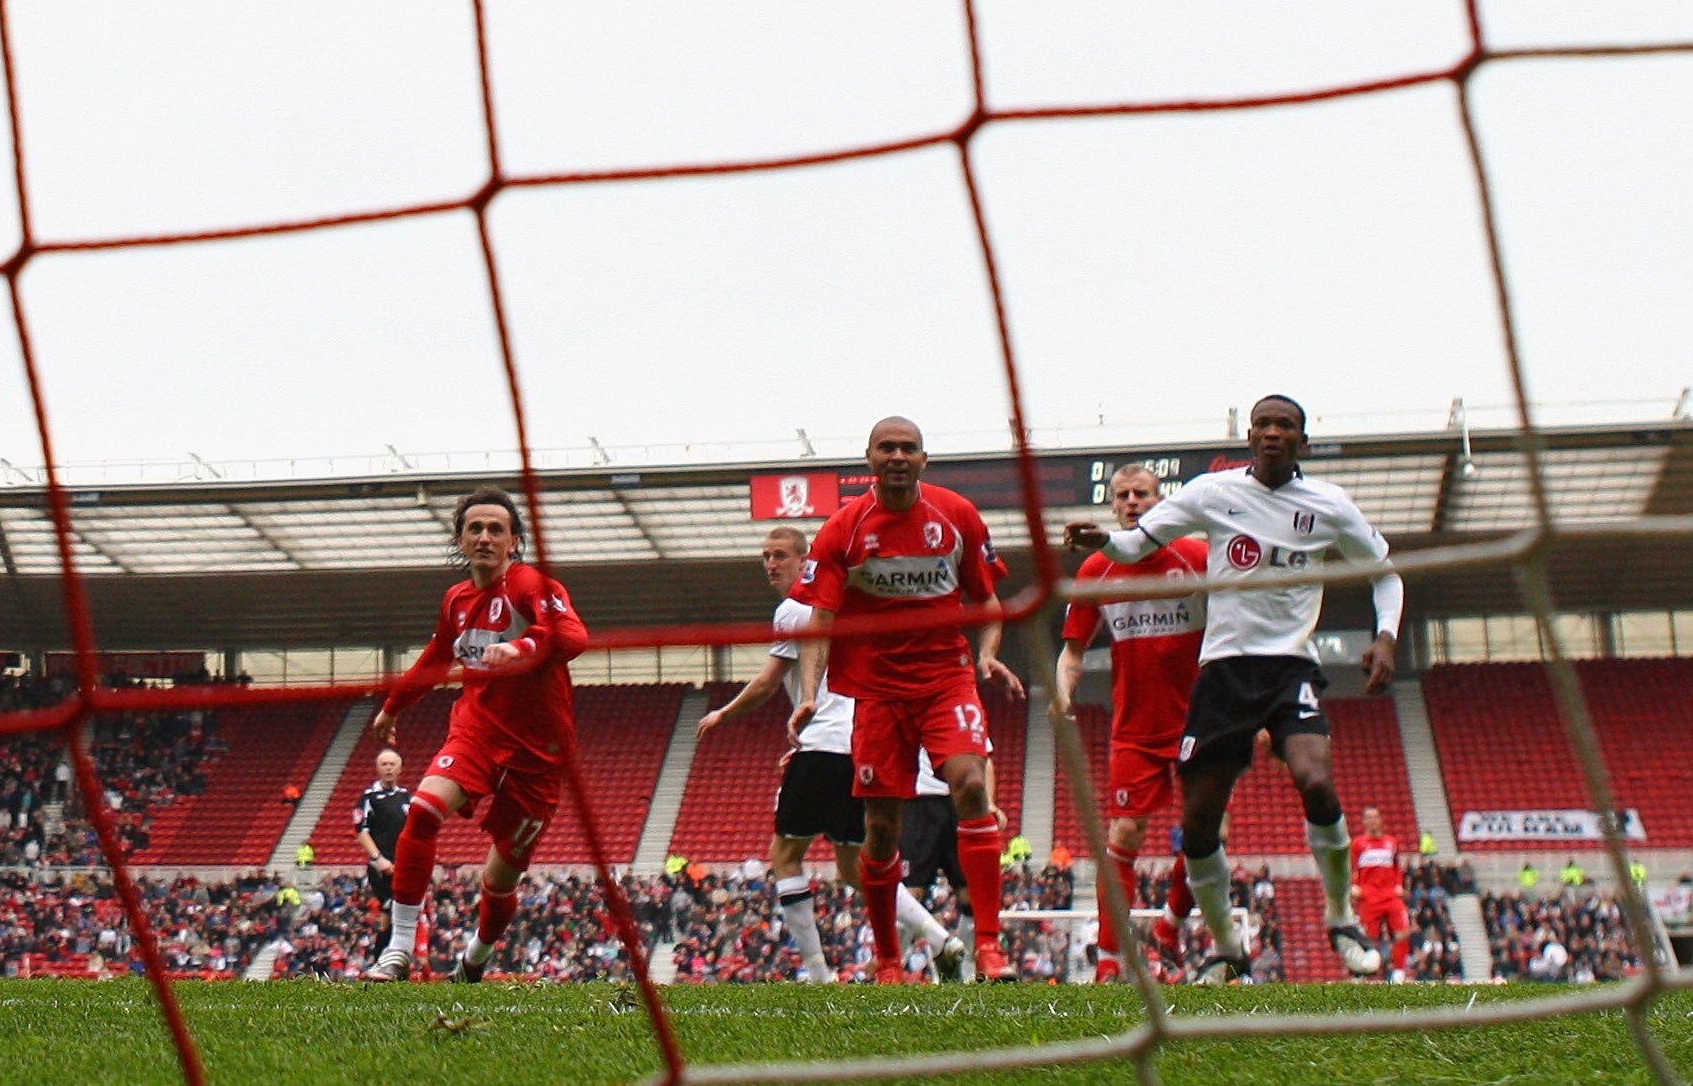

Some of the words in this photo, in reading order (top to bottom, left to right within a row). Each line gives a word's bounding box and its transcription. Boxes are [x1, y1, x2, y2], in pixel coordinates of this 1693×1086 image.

[1270, 546, 1308, 571] LG
[861, 569, 949, 588] GARMIN
[1113, 611, 1190, 631] GARMIN
[1299, 682, 1319, 710] 4
[954, 704, 984, 732] 12
[514, 818, 545, 846] 17
